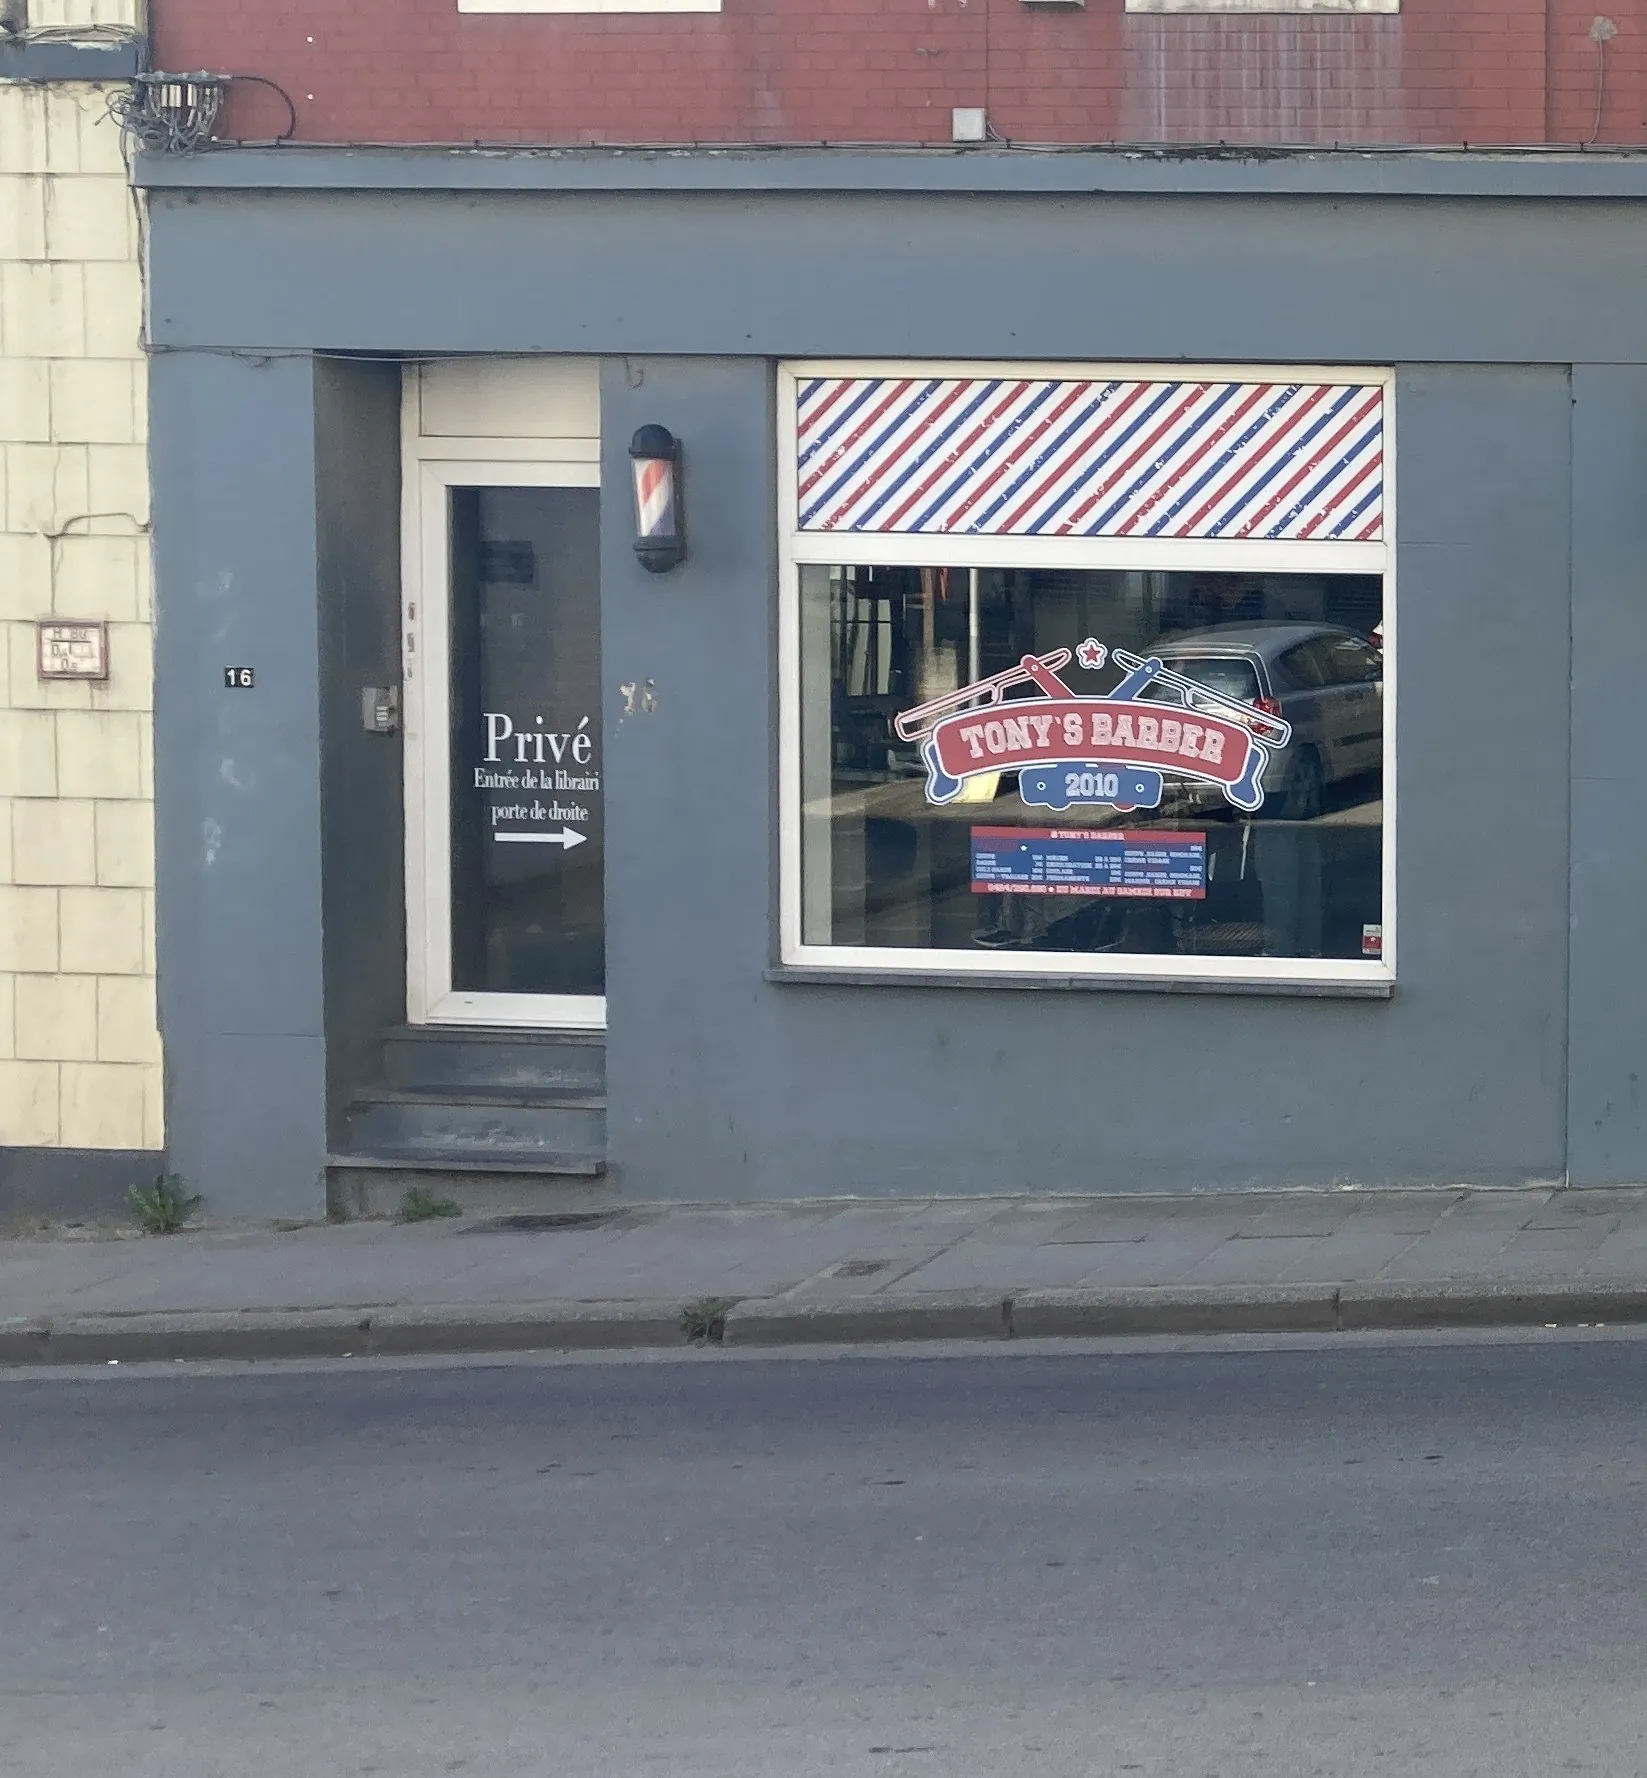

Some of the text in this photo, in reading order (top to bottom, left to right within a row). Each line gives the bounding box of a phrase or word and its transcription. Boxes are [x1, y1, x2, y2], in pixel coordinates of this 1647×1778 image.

[227, 669, 252, 687] 16
[483, 712, 592, 764] Privé
[959, 712, 1226, 765] TONY'S BARBER
[474, 767, 519, 789] Entrée
[521, 769, 539, 789] de
[540, 769, 553, 790] la
[1064, 772, 1119, 798] 2010
[491, 800, 589, 825] porte de droite
